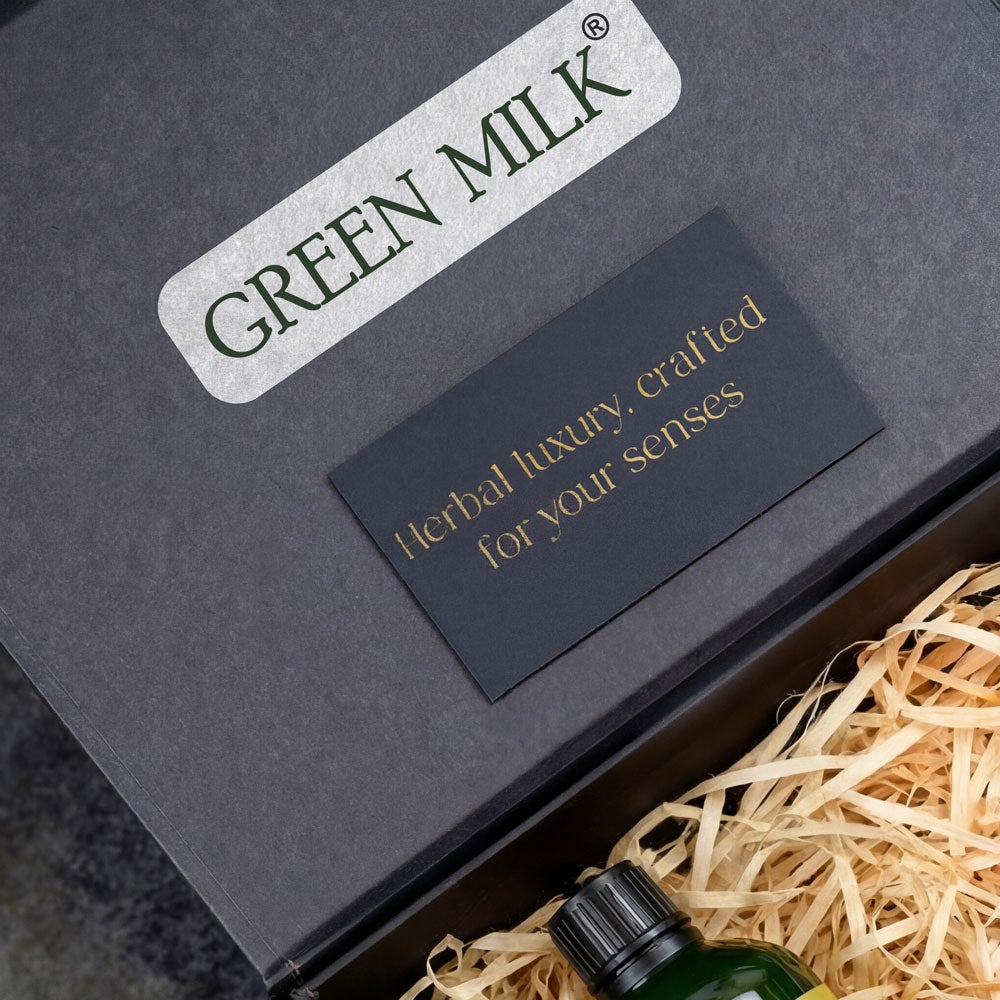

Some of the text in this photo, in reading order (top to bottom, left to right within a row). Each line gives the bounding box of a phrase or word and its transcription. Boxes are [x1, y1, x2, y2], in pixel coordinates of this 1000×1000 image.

[203, 168, 443, 360] GREEN
[394, 463, 514, 560] Herbal
[636, 294, 767, 398] crafted
[478, 382, 745, 570] for your senses
